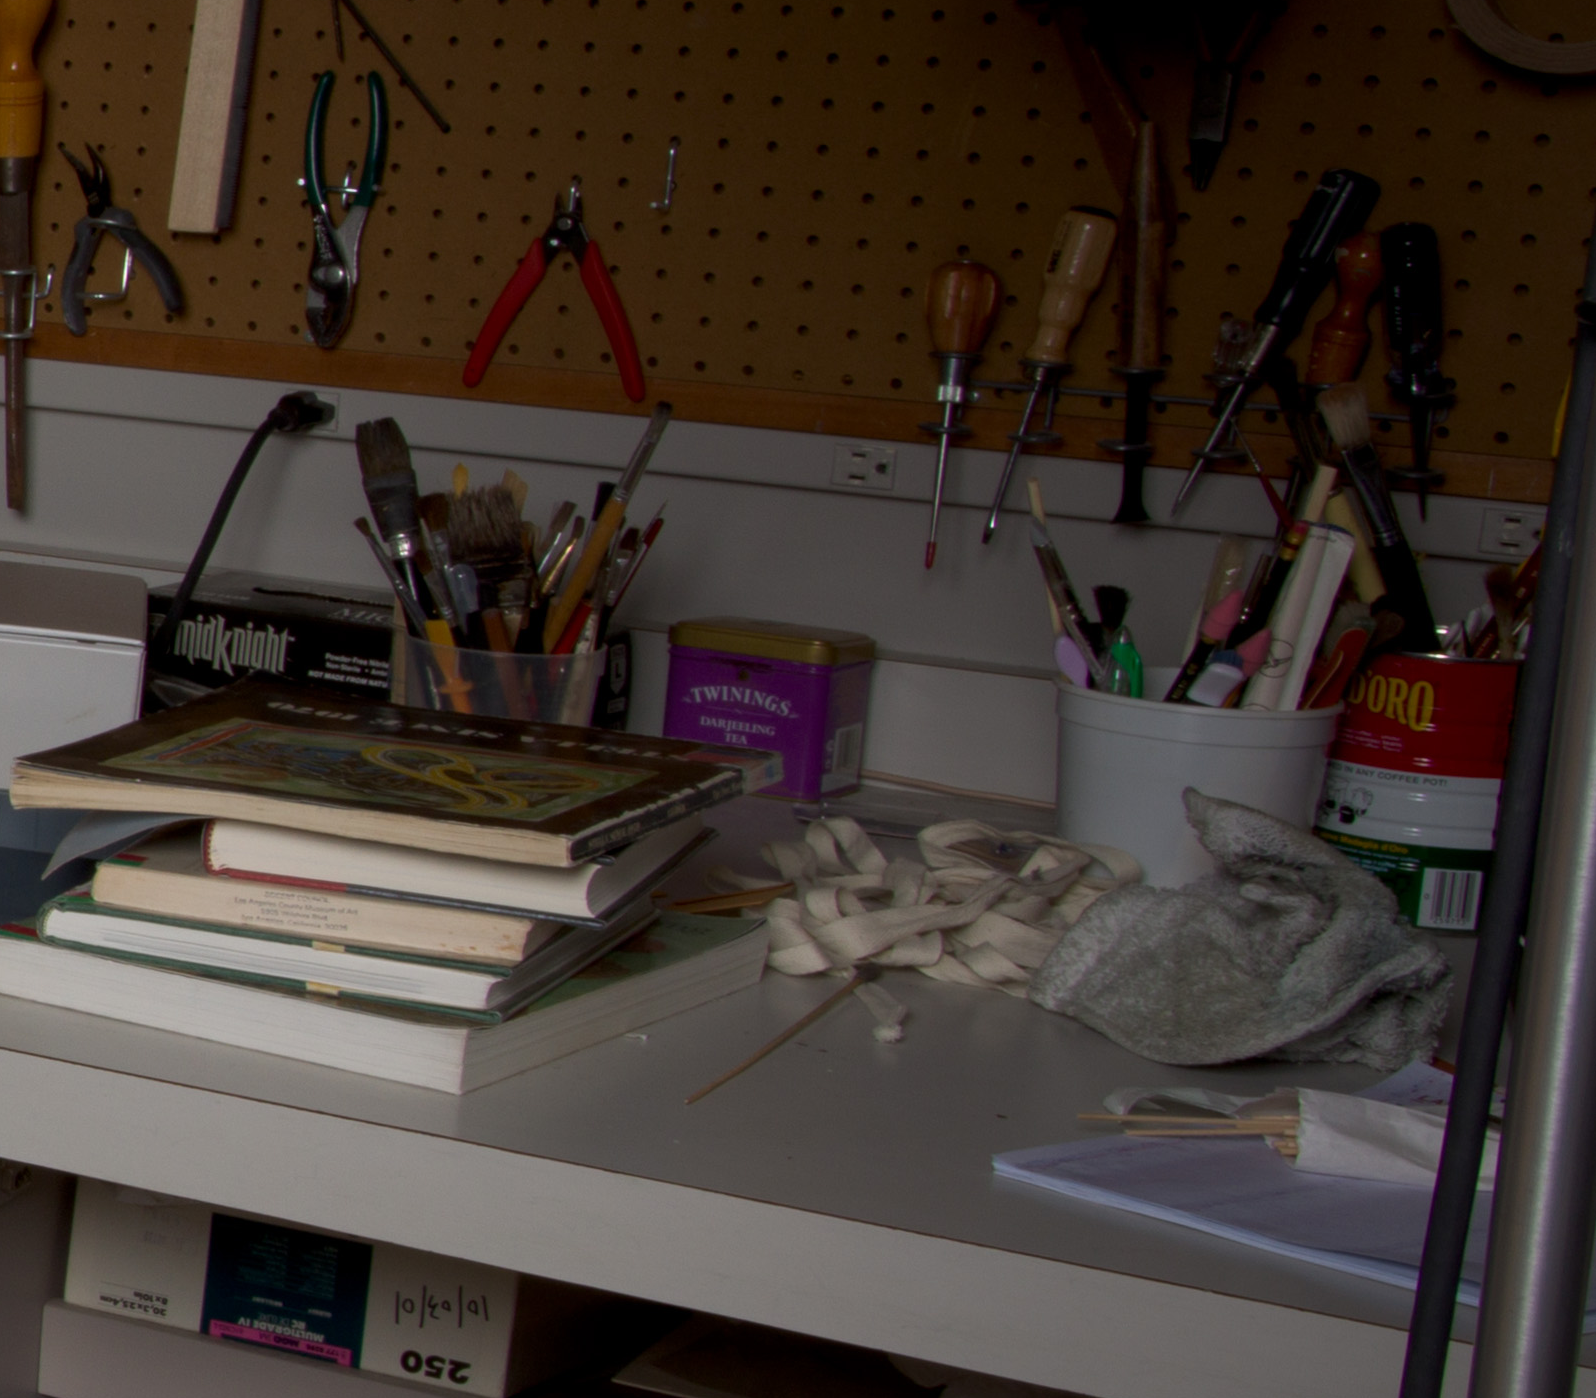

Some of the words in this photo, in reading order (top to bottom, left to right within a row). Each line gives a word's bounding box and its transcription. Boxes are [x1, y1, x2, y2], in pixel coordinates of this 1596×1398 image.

[324, 671, 346, 684] MADE
[346, 674, 366, 687] FROM
[689, 686, 792, 717] TWININGS
[1346, 668, 1436, 732] D'ORO
[700, 715, 775, 737] DARJEELING
[724, 733, 748, 746] TEA
[1356, 767, 1375, 778] ANY
[1378, 770, 1419, 785] COFFEE
[236, 1316, 251, 1327] IV
[252, 1319, 325, 1343] MULTIGRADE
[291, 1319, 307, 1330] RC
[399, 1349, 472, 1384] 250
